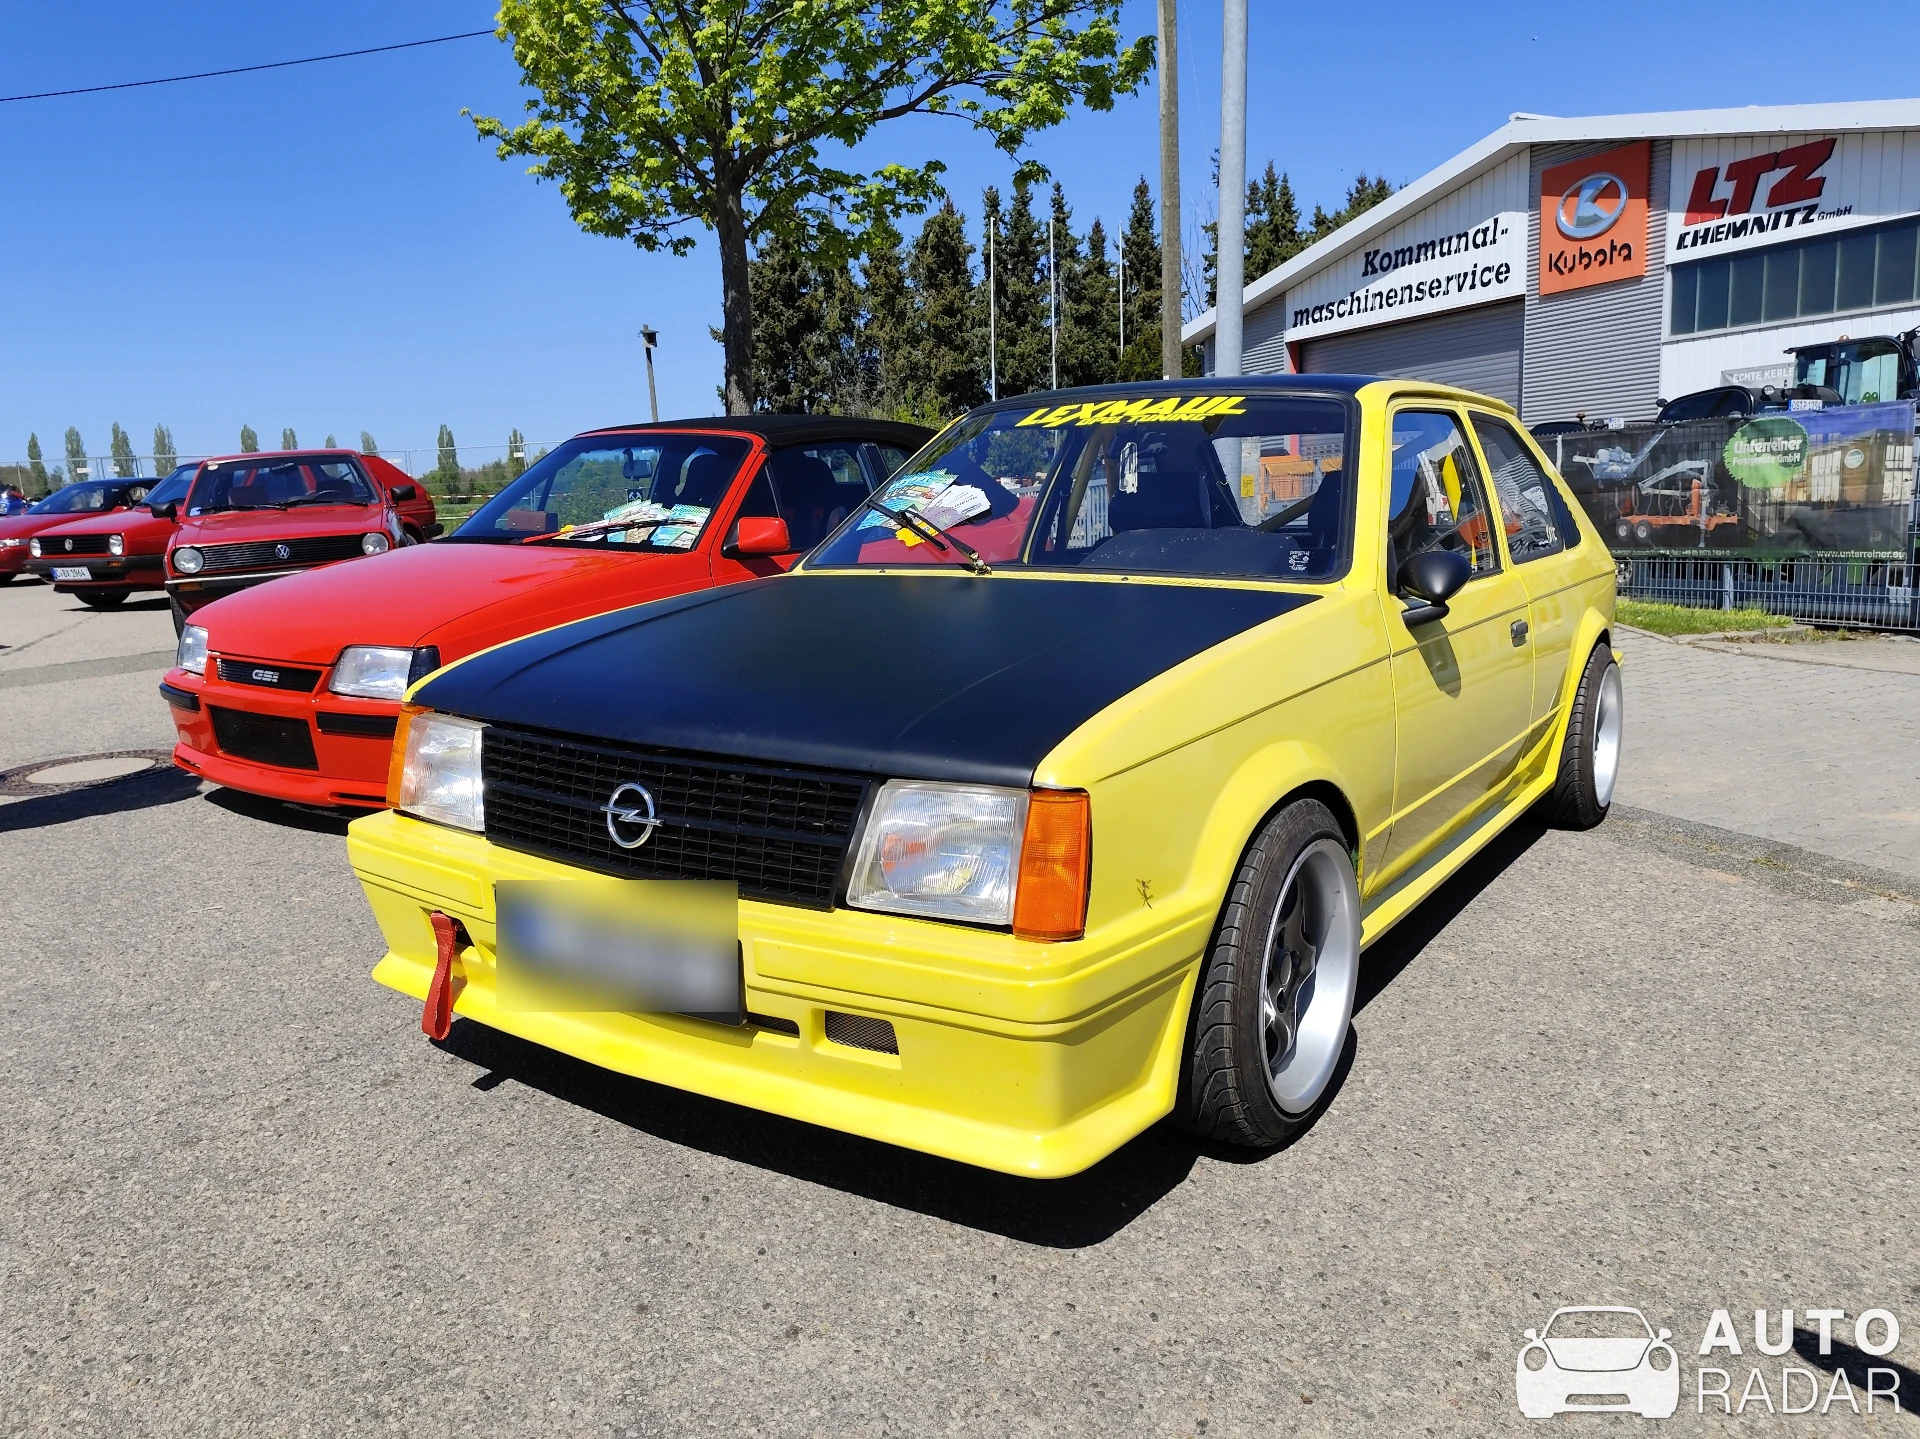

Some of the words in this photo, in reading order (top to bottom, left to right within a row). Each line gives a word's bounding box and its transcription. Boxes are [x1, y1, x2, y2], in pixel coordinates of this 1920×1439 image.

[1684, 137, 1837, 227] LTZ
[1676, 203, 1819, 251] CHEMNITZ
[1817, 205, 1853, 221] GmbH
[1361, 217, 1509, 278] Kommunal-
[1548, 239, 1632, 276] Kubota
[1292, 262, 1511, 328] maschinenservice
[1733, 371, 1762, 382] ECHTE
[1764, 367, 1794, 379] KERLE
[1014, 396, 1247, 428] LEXMAUL
[1733, 438, 1802, 454] Unterreiner
[1776, 453, 1801, 463] GmbH
[1816, 549, 1905, 559] www.unterreiner.eu
